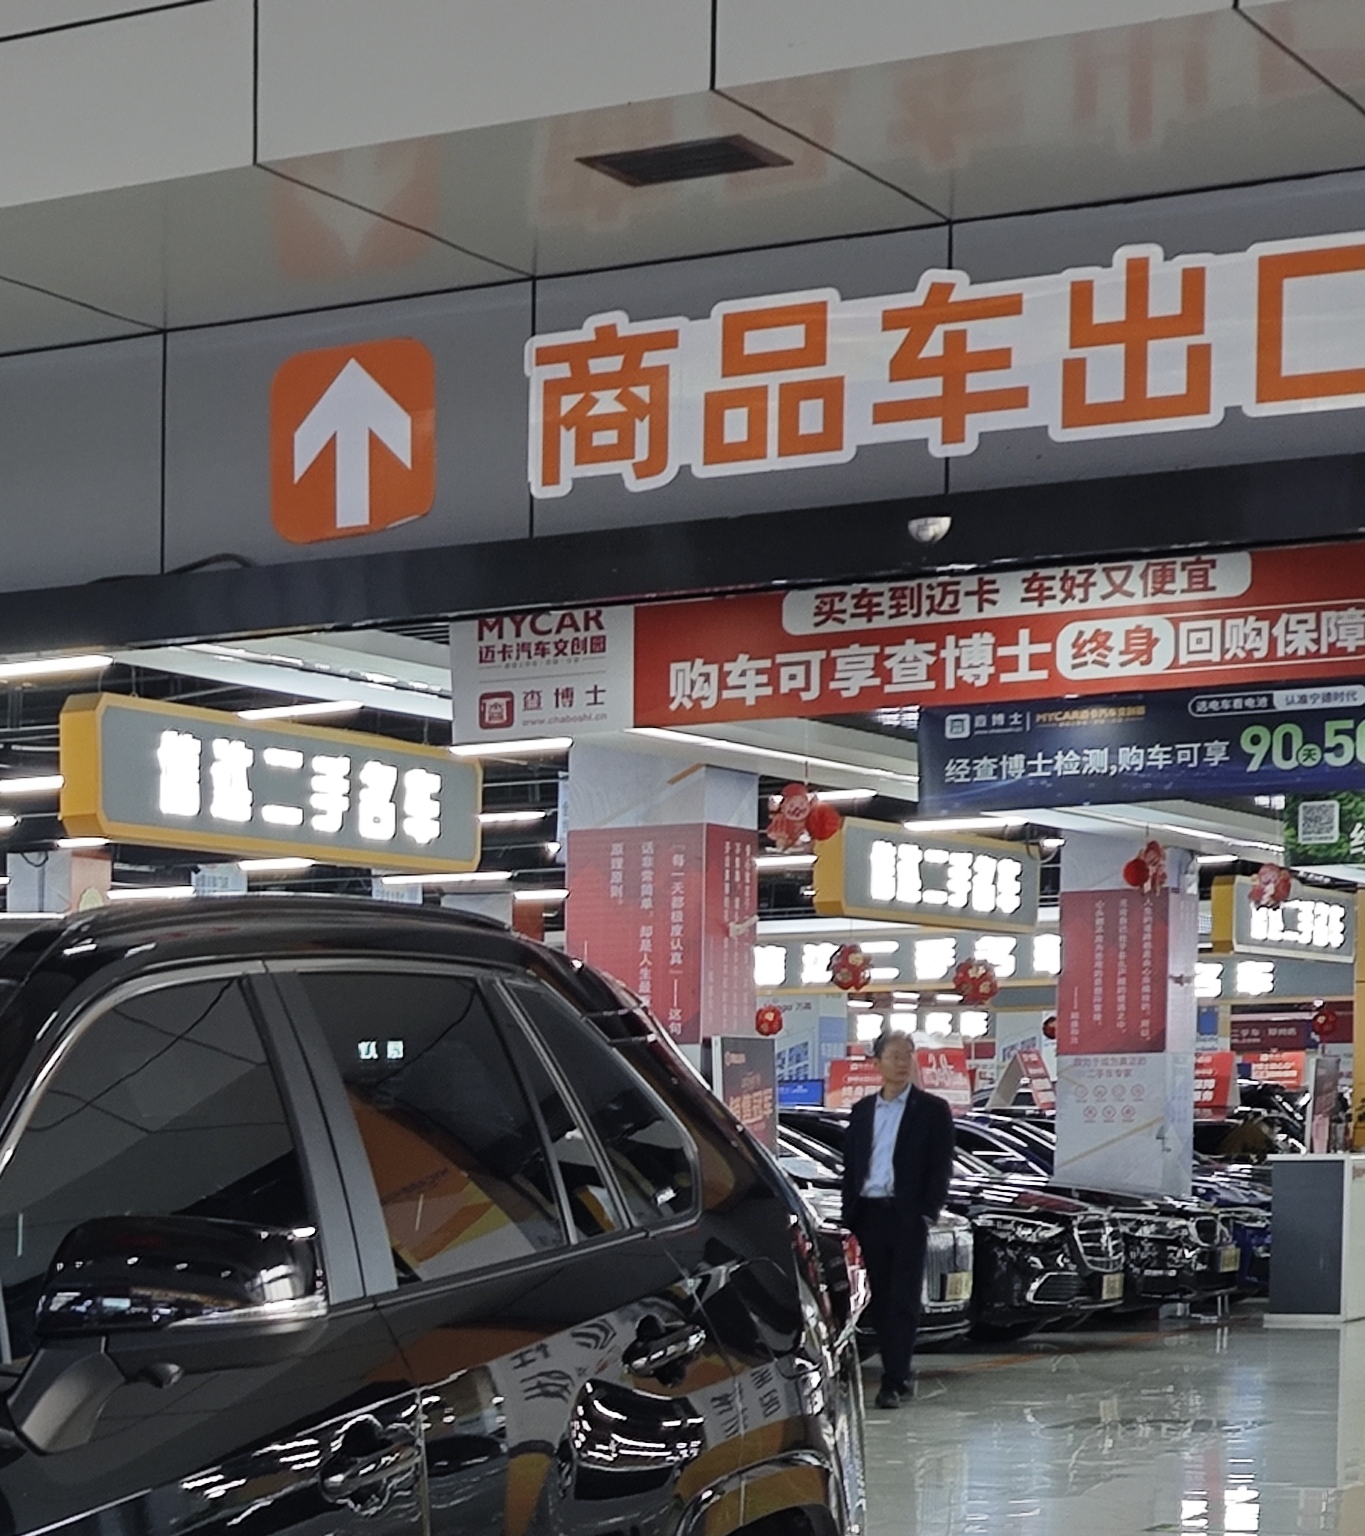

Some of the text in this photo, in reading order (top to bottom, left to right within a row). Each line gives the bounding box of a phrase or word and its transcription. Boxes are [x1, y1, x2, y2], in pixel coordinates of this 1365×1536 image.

[529, 236, 1365, 494] 商品车出口
[477, 608, 604, 642] MYCAR
[814, 555, 1218, 627] 买车到迈卡 车好又便宜
[670, 608, 1365, 711] 购车可享查博士 终身 回购保障
[945, 739, 1230, 784] 经查博士检测,购车可享
